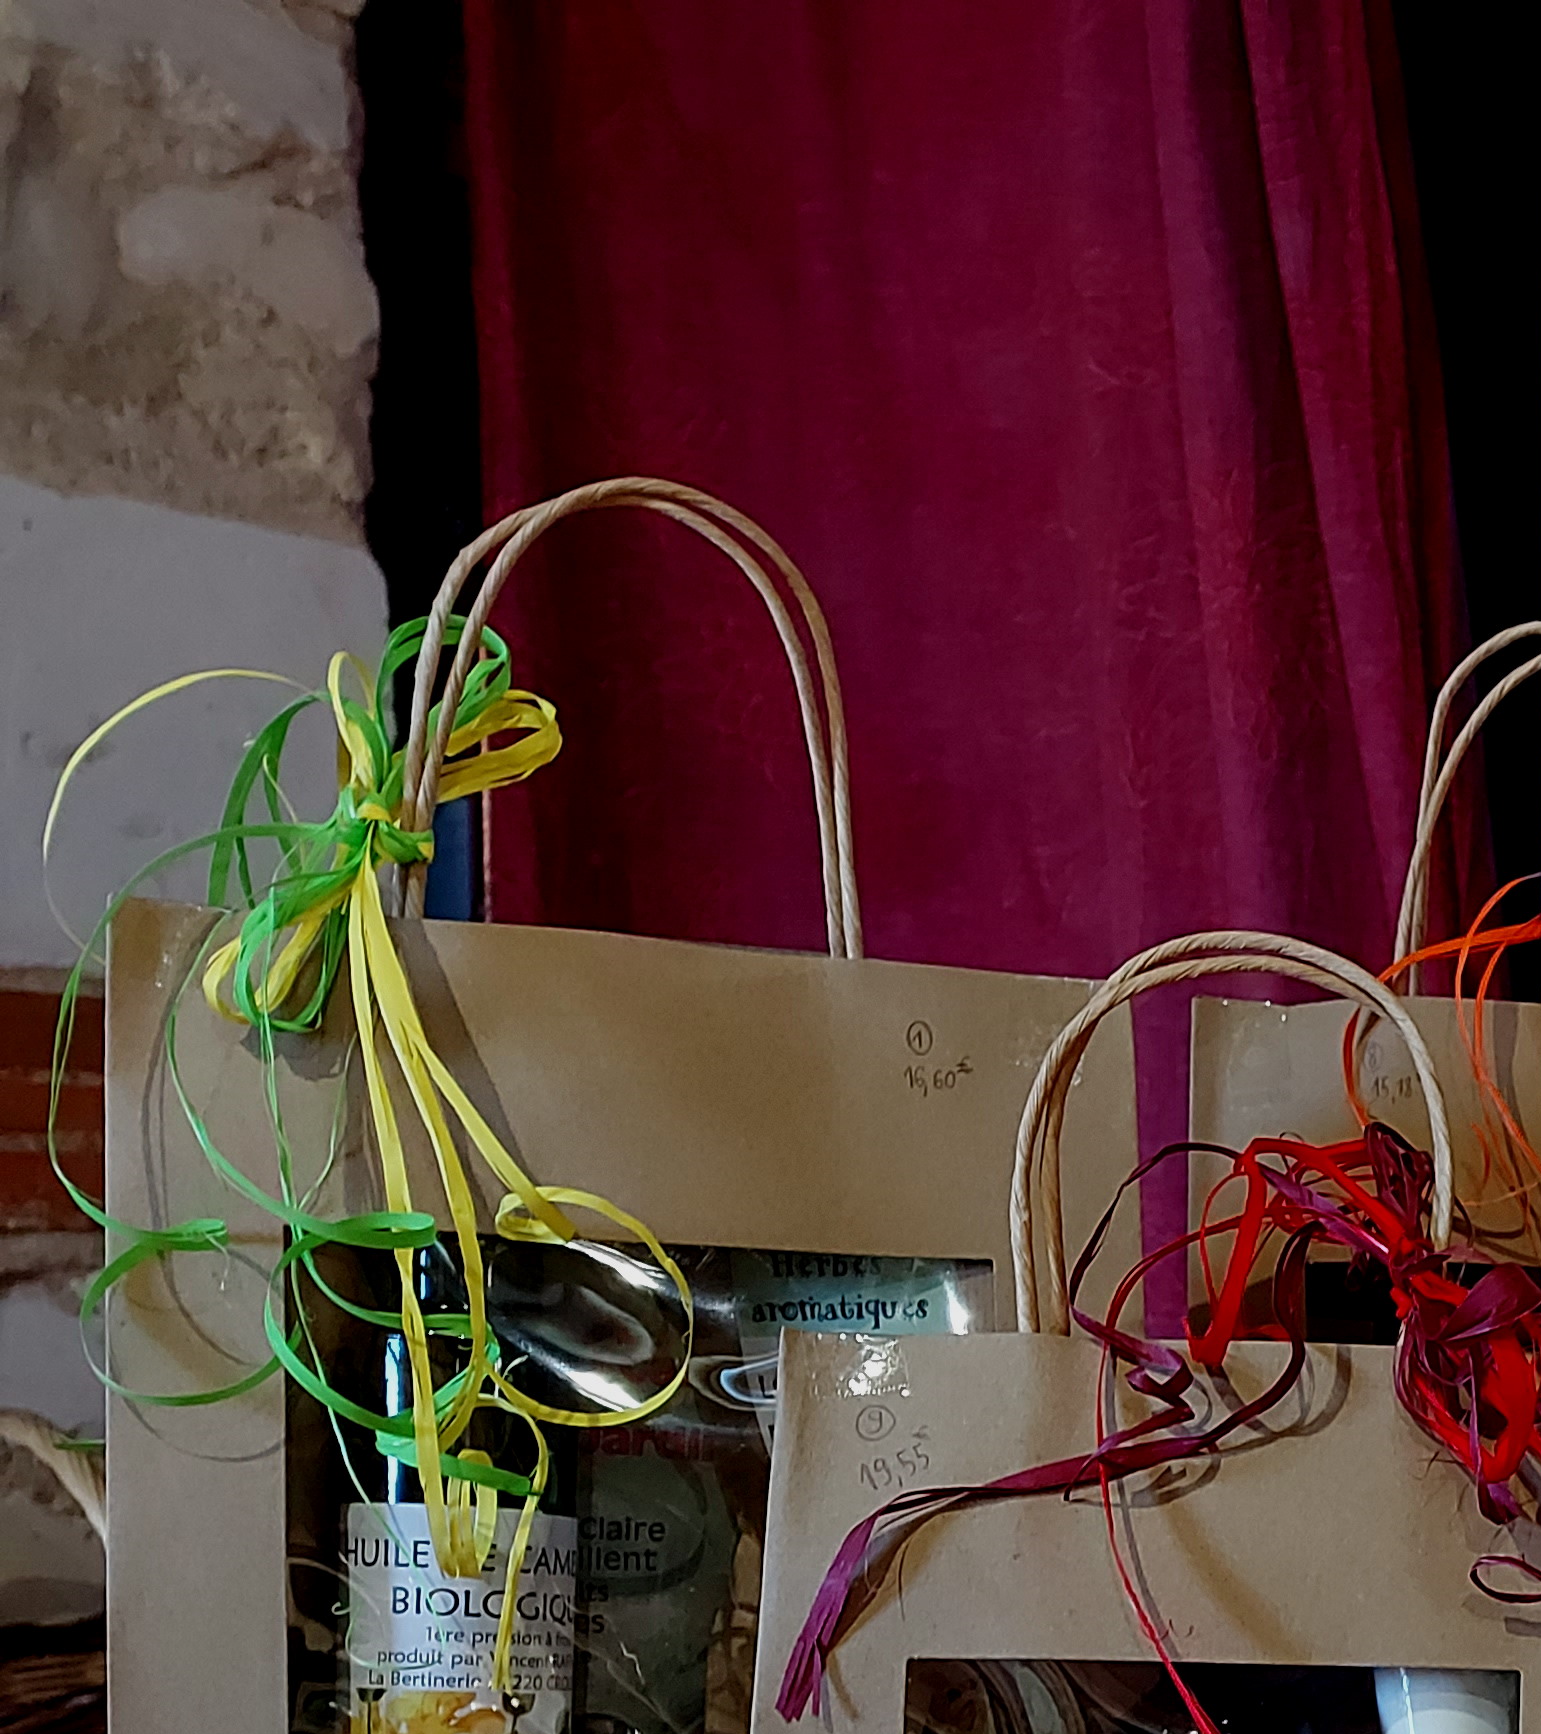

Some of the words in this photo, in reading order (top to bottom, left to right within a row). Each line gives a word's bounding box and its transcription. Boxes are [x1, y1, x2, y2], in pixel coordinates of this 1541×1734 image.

[751, 1295, 929, 1329] aromatiques
[378, 1648, 443, 1666] produit
[451, 1653, 482, 1667] par
[368, 1670, 384, 1685] La
